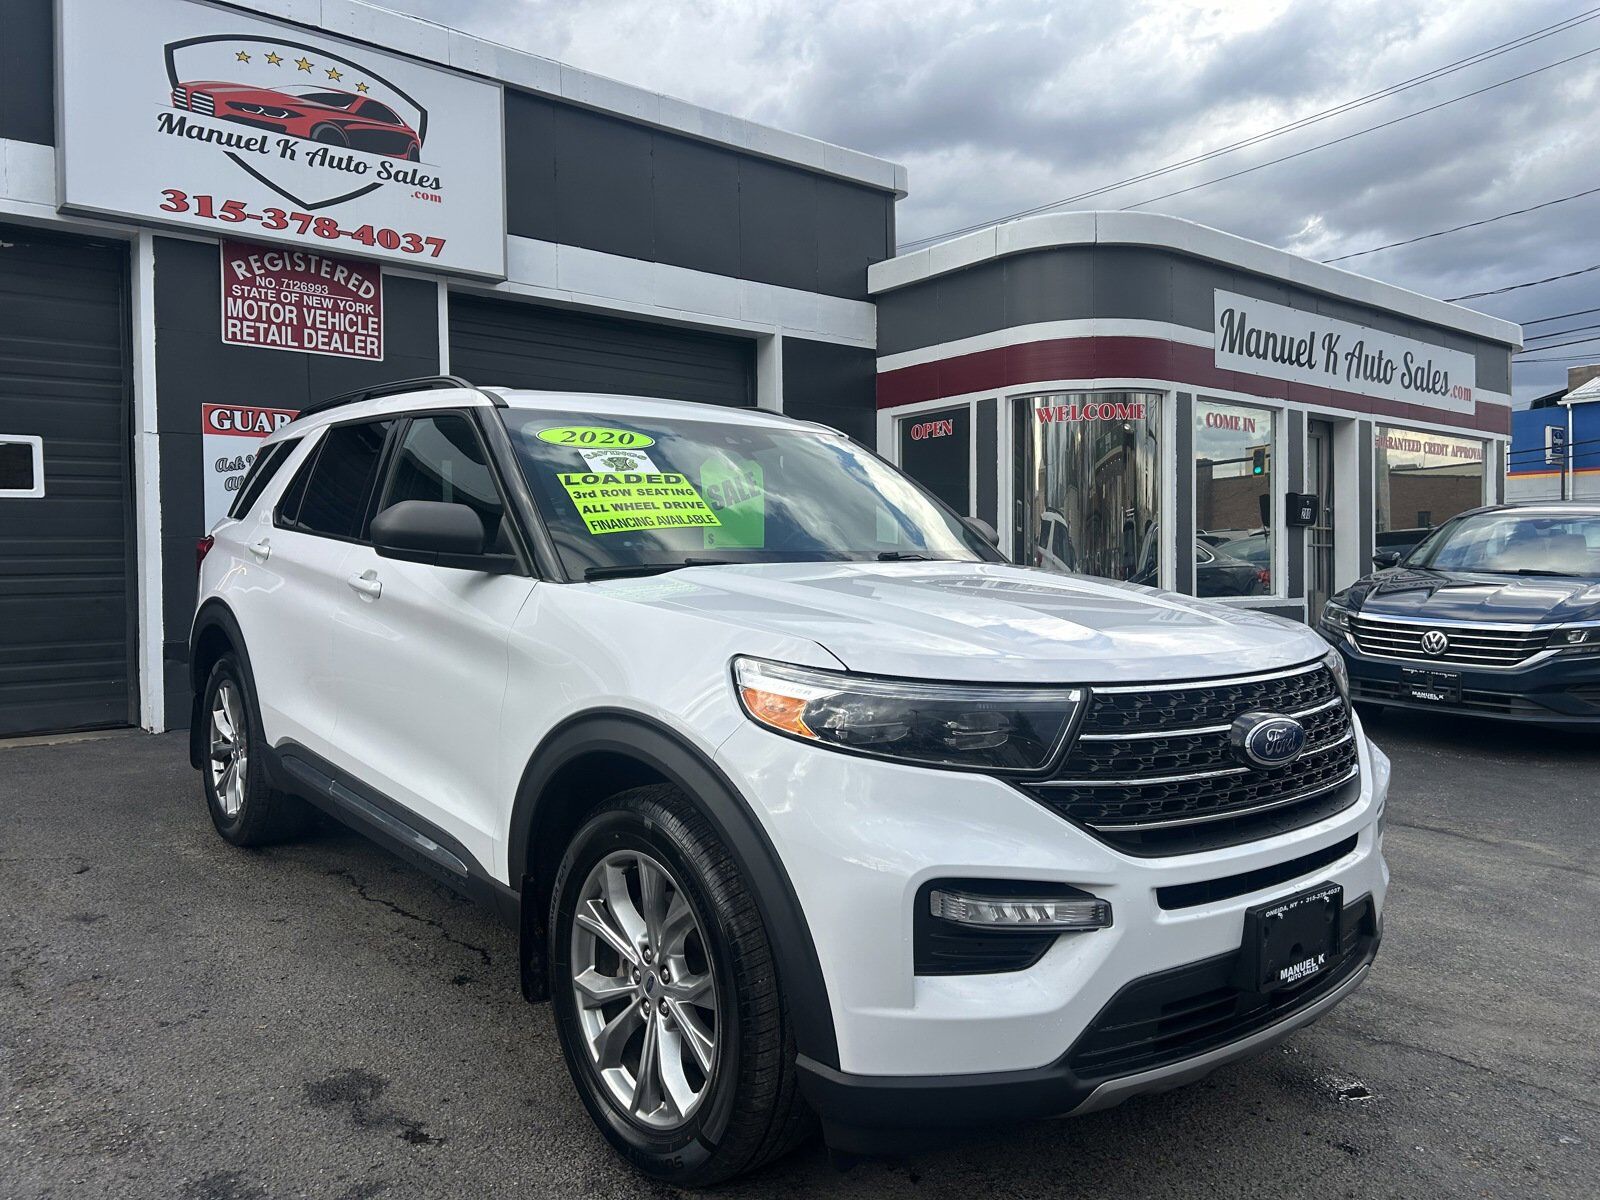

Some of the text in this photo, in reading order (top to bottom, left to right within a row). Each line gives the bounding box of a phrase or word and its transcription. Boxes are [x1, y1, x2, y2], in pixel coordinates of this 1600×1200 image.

[157, 112, 443, 190] Manuel K Auto Sales
[410, 191, 442, 203] .com
[159, 189, 447, 258] 315-378-4037
[231, 252, 375, 299] REGISTERED
[256, 276, 329, 295] NO. 7126993
[232, 285, 375, 315] STATE OF NEW YORK
[227, 297, 379, 336] MOTOR VEHICLE
[227, 319, 379, 356] RETAIL DEALER
[1219, 308, 1317, 370] Manuel
[1321, 332, 1341, 375] K
[1344, 340, 1397, 385] Auto
[1036, 402, 1147, 424] WELCOME
[1205, 412, 1256, 433] COME IN
[560, 430, 635, 446] 2020
[911, 419, 953, 440] OPEN
[1424, 441, 1449, 457] CREDIT
[215, 456, 245, 473] Ask
[564, 473, 684, 486] LOADED
[572, 487, 695, 500] 3rd ROW SEATING
[706, 471, 762, 512] SALE
[582, 501, 706, 515] ALL WHEEL DRIVE
[588, 514, 717, 532] FINANCING AVAILABLE
[1265, 727, 1297, 756] Ford
[1289, 901, 1299, 909] NY
[1280, 953, 1326, 981] MANUEL K
[1287, 965, 1319, 983] AUTO SALES
